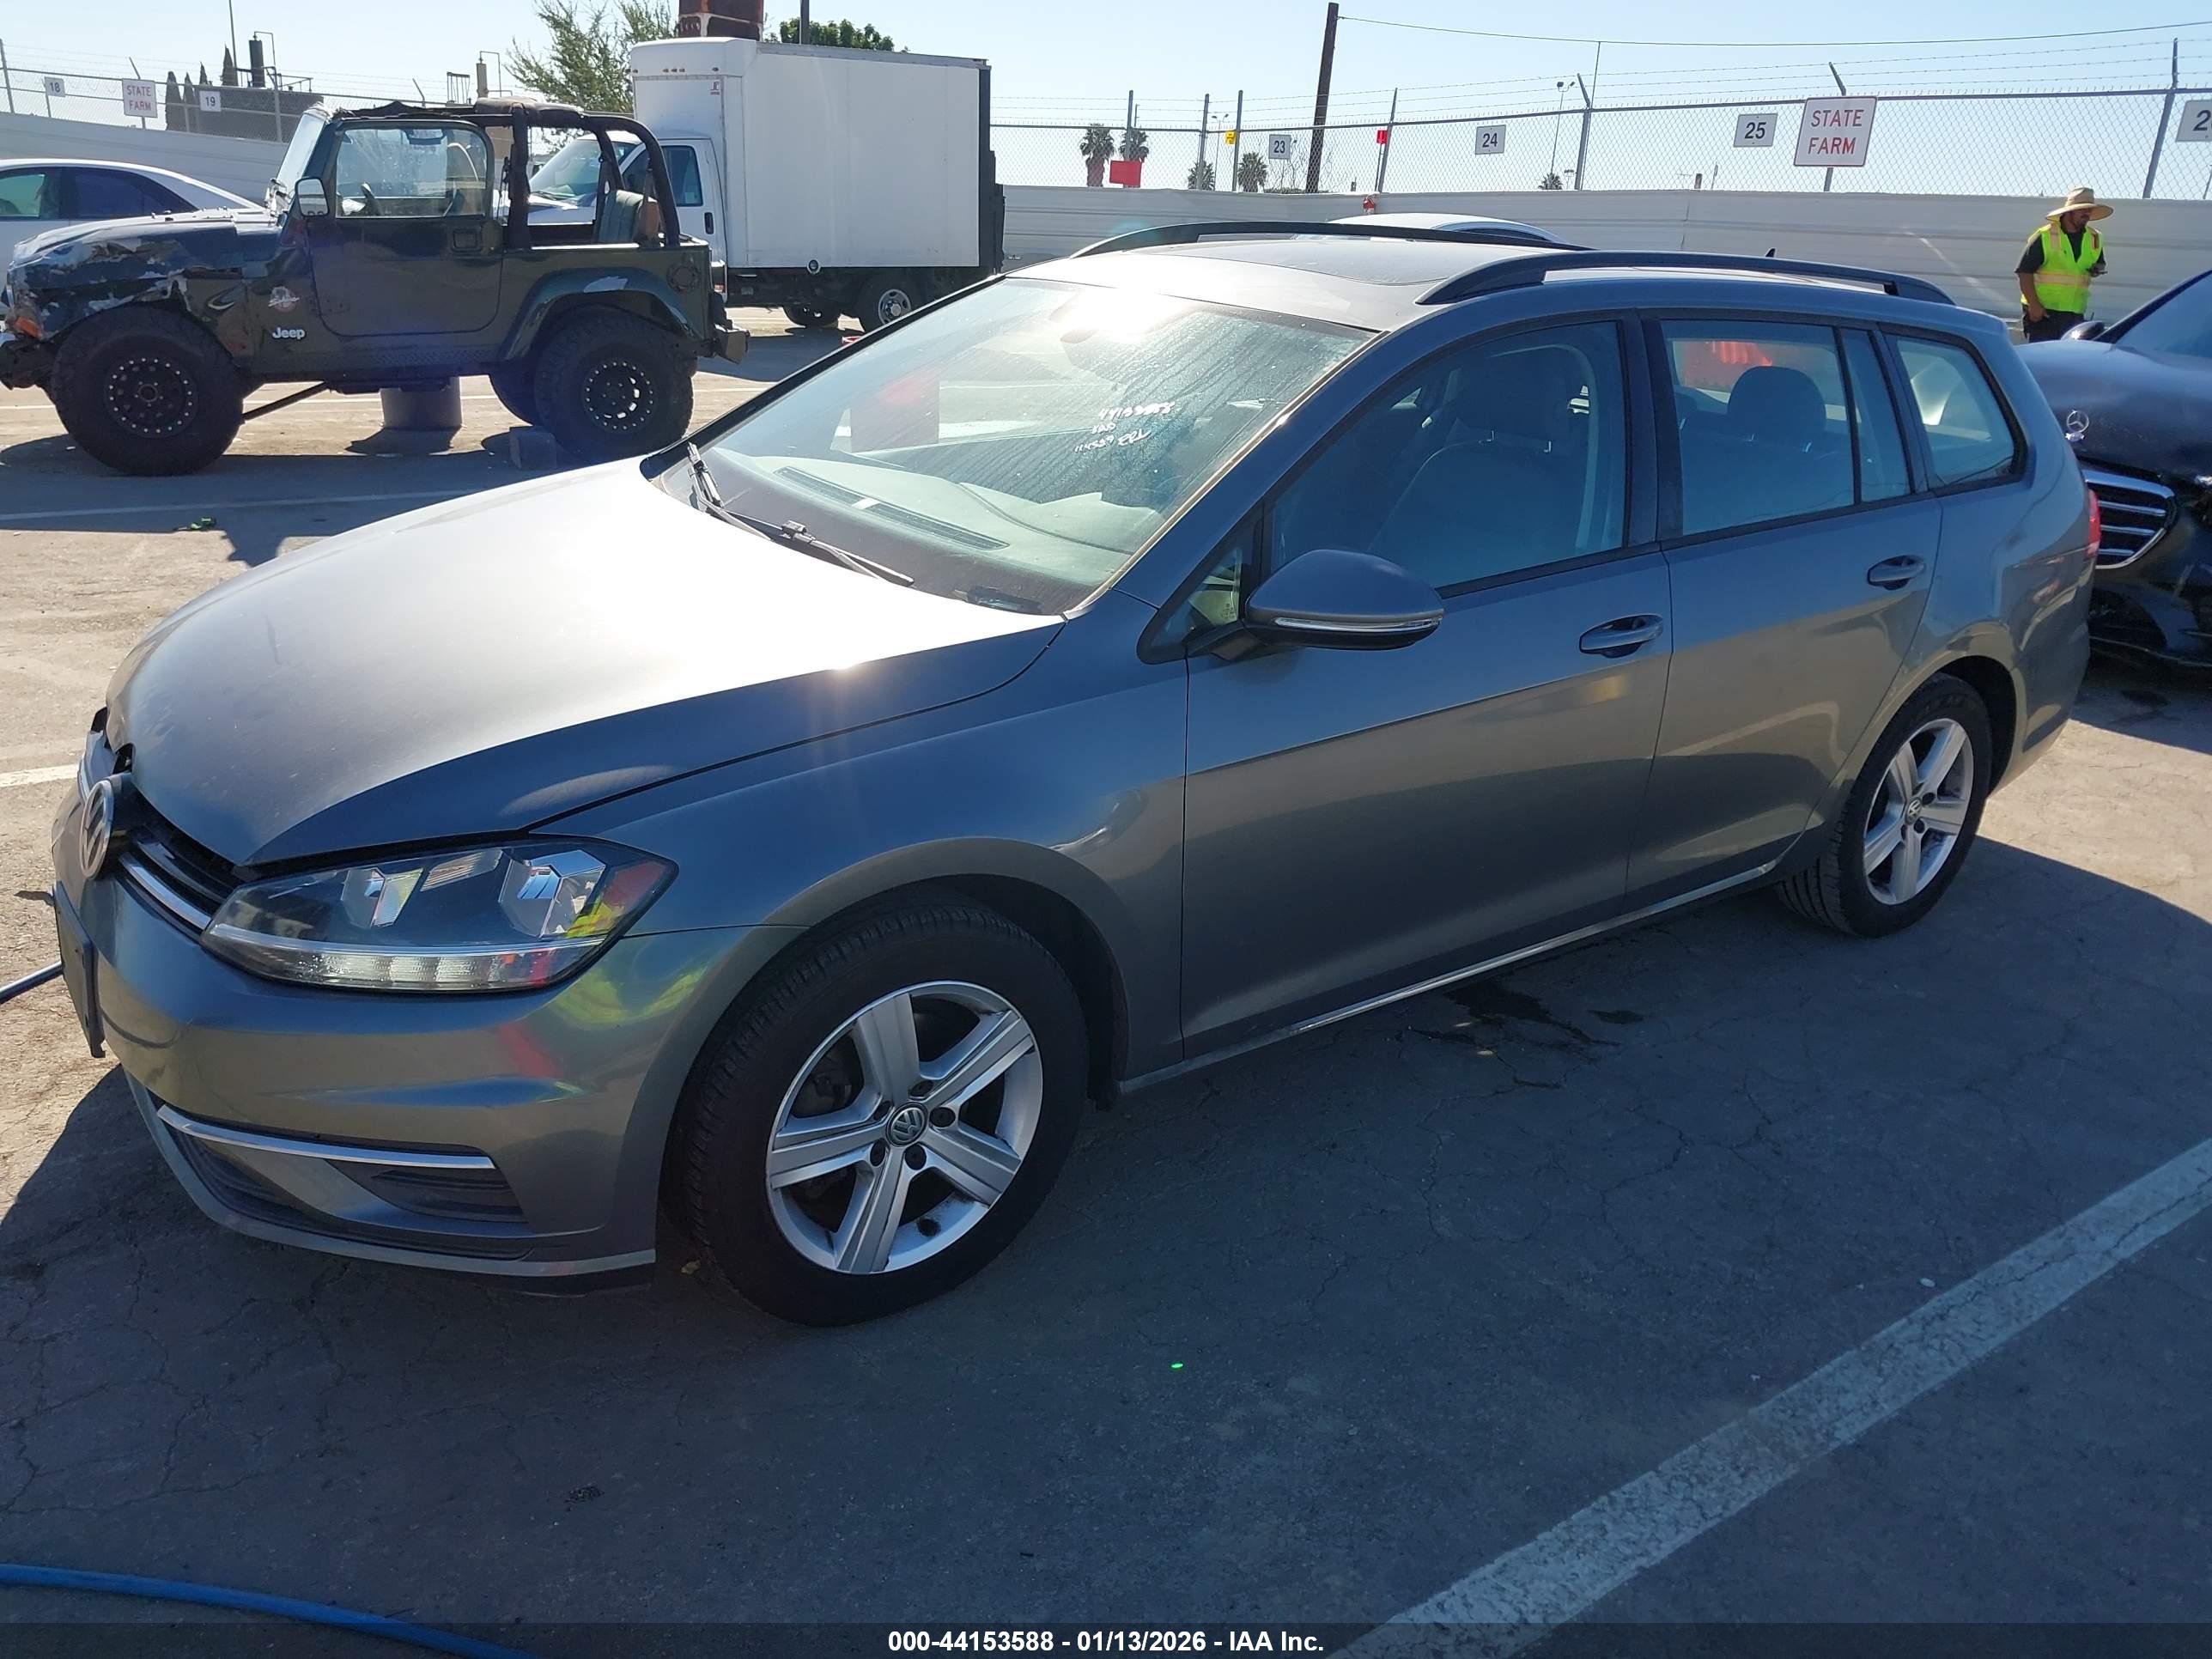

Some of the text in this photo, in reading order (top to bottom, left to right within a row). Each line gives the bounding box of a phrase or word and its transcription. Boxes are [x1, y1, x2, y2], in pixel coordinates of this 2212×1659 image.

[51, 82, 60, 93] 18
[128, 86, 151, 96] STATE
[130, 100, 151, 111] FARM
[205, 96, 216, 106] 19
[1811, 109, 1864, 127] STATE
[2192, 109, 2212, 131] 2
[1744, 122, 1766, 139] 25
[1273, 140, 1286, 154] 23
[1482, 132, 1498, 148] 24
[1808, 137, 1856, 155] FARM
[272, 326, 306, 340] Jeep
